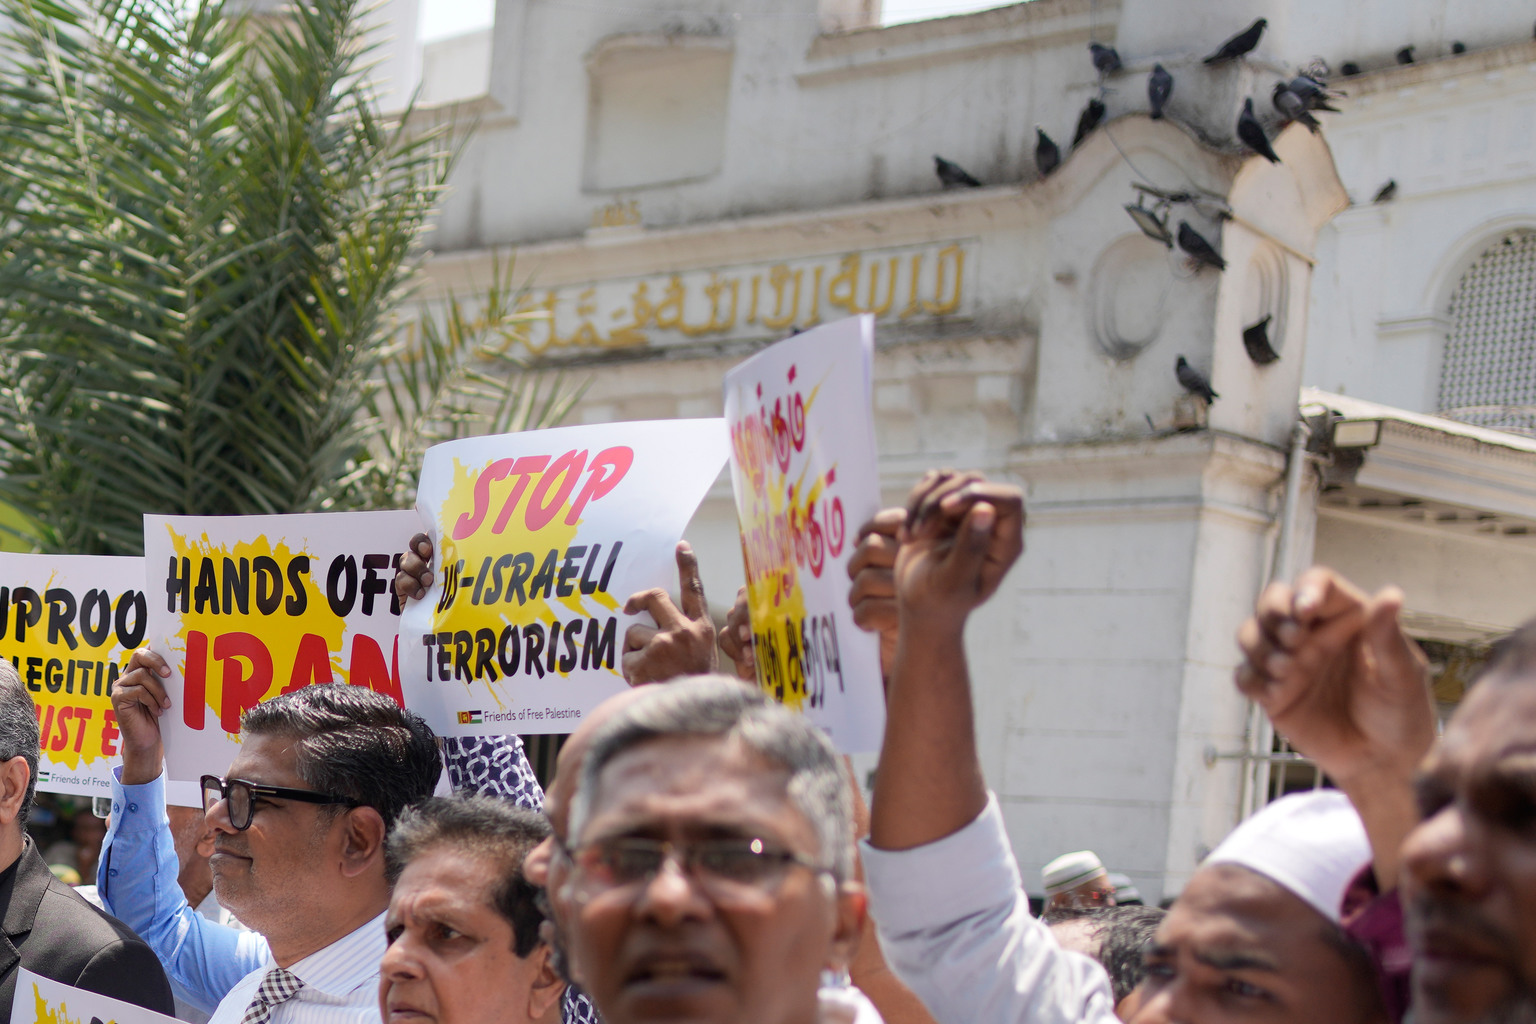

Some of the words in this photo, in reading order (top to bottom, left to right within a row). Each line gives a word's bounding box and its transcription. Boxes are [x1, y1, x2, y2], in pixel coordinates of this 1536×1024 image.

[452, 445, 635, 540] STOP
[165, 554, 311, 617] HANDS
[437, 540, 624, 614] US-ISRAELI
[183, 630, 406, 734] IRAN
[422, 616, 618, 685] TERRORISM
[35, 704, 93, 753] UST
[484, 709, 517, 722] Friends
[518, 708, 526, 720] of
[526, 708, 544, 720] Free
[545, 707, 581, 720] Palestine
[50, 773, 80, 786] Friends
[81, 774, 90, 786] of
[91, 776, 110, 788] Free
